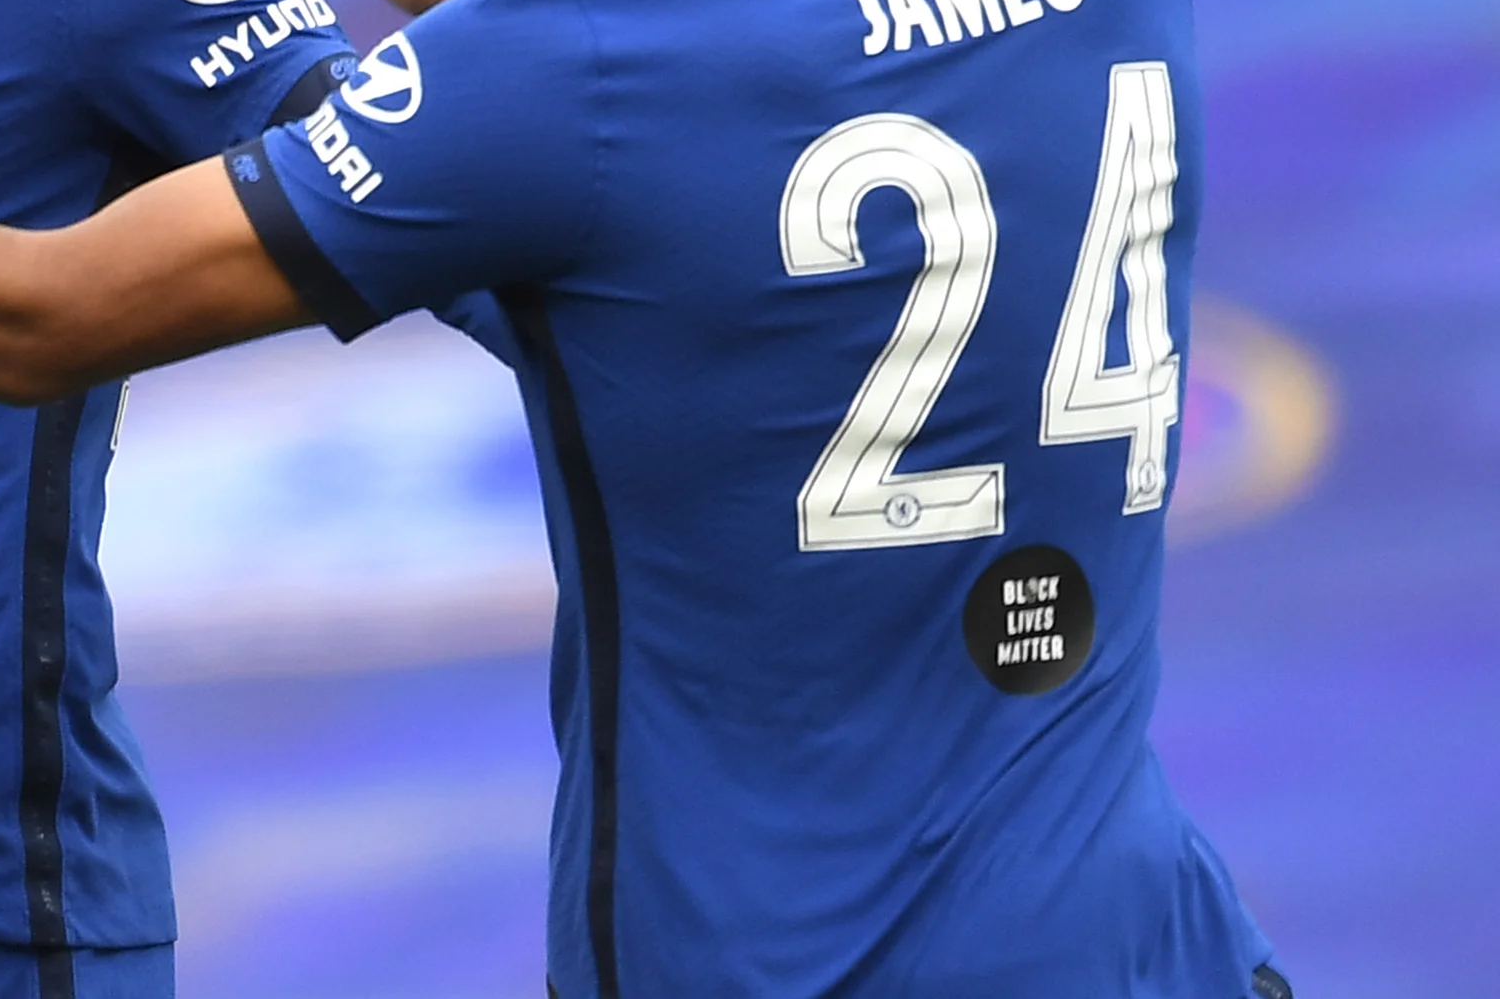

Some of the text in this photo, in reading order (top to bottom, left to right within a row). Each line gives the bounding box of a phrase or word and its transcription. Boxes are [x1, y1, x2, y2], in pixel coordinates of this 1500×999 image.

[779, 61, 1180, 551] 24
[1007, 605, 1055, 636] LIVES
[997, 634, 1064, 667] MATTER
